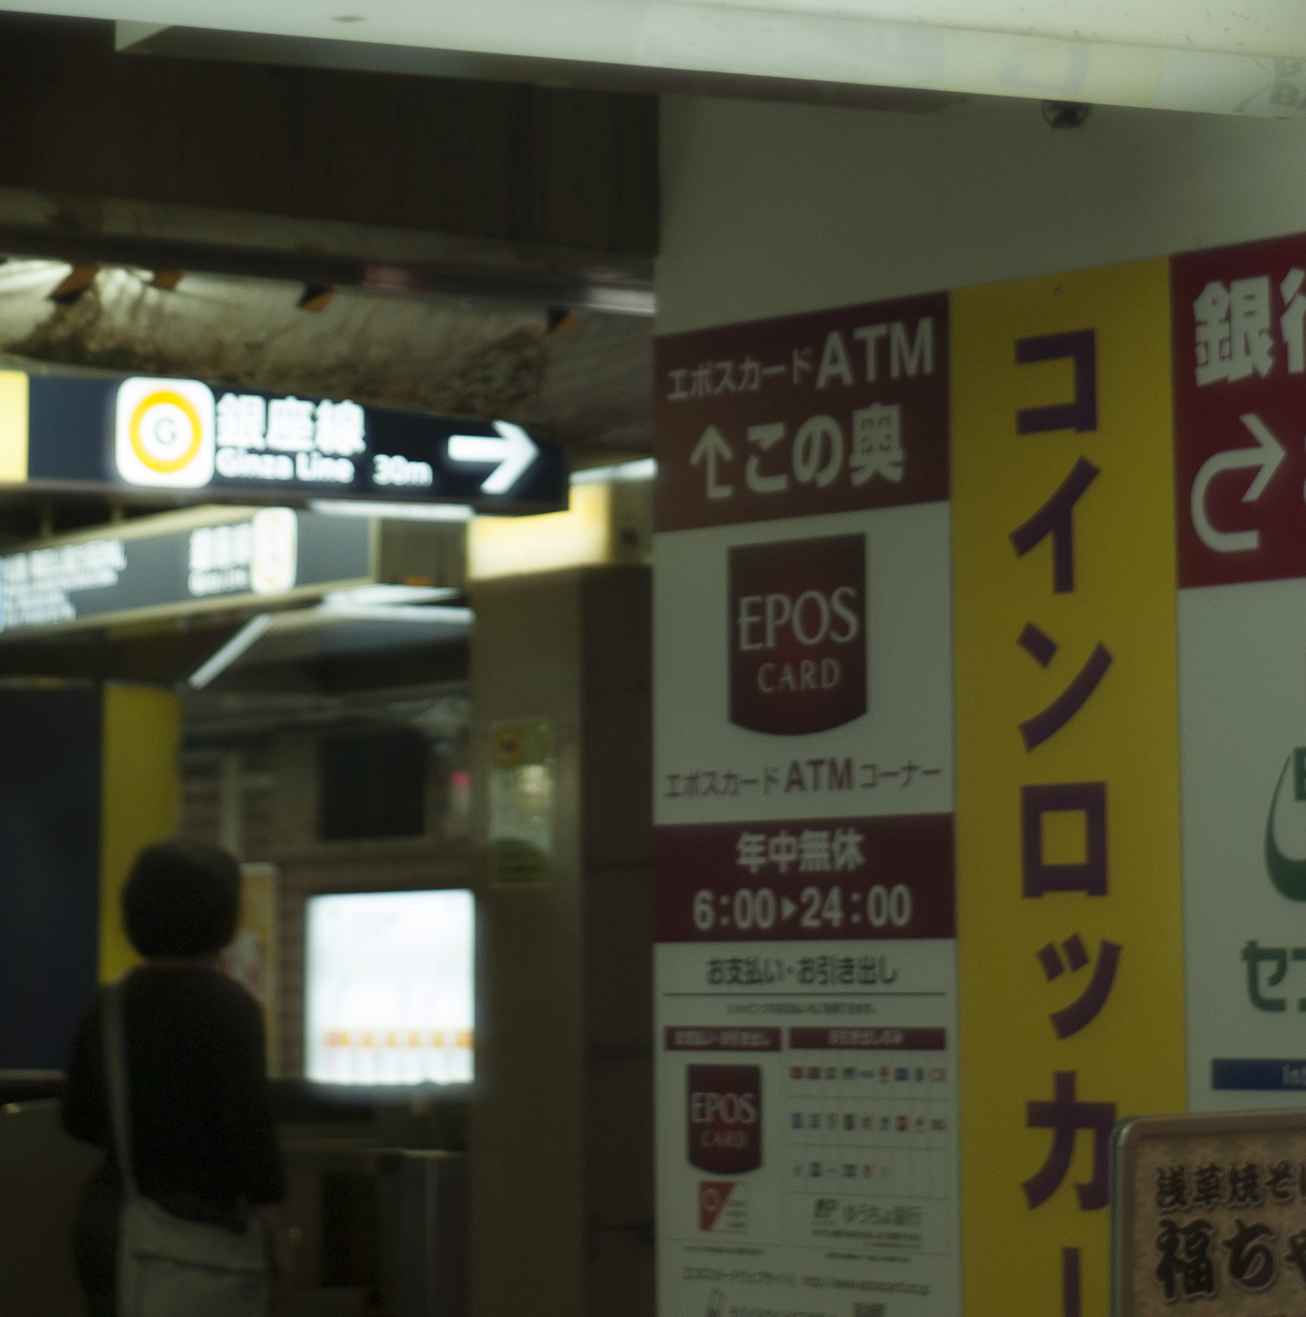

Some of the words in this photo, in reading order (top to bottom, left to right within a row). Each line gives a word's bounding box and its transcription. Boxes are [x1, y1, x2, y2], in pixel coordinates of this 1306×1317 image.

[215, 447, 294, 480] Ginza
[295, 451, 354, 483] Line
[747, 403, 905, 487] この奥
[738, 587, 860, 651] EPOS
[756, 658, 842, 693] CARD
[1009, 328, 1123, 1317] コインロッカー
[735, 827, 865, 874] 年中無休
[691, 1091, 759, 1124] EPOS
